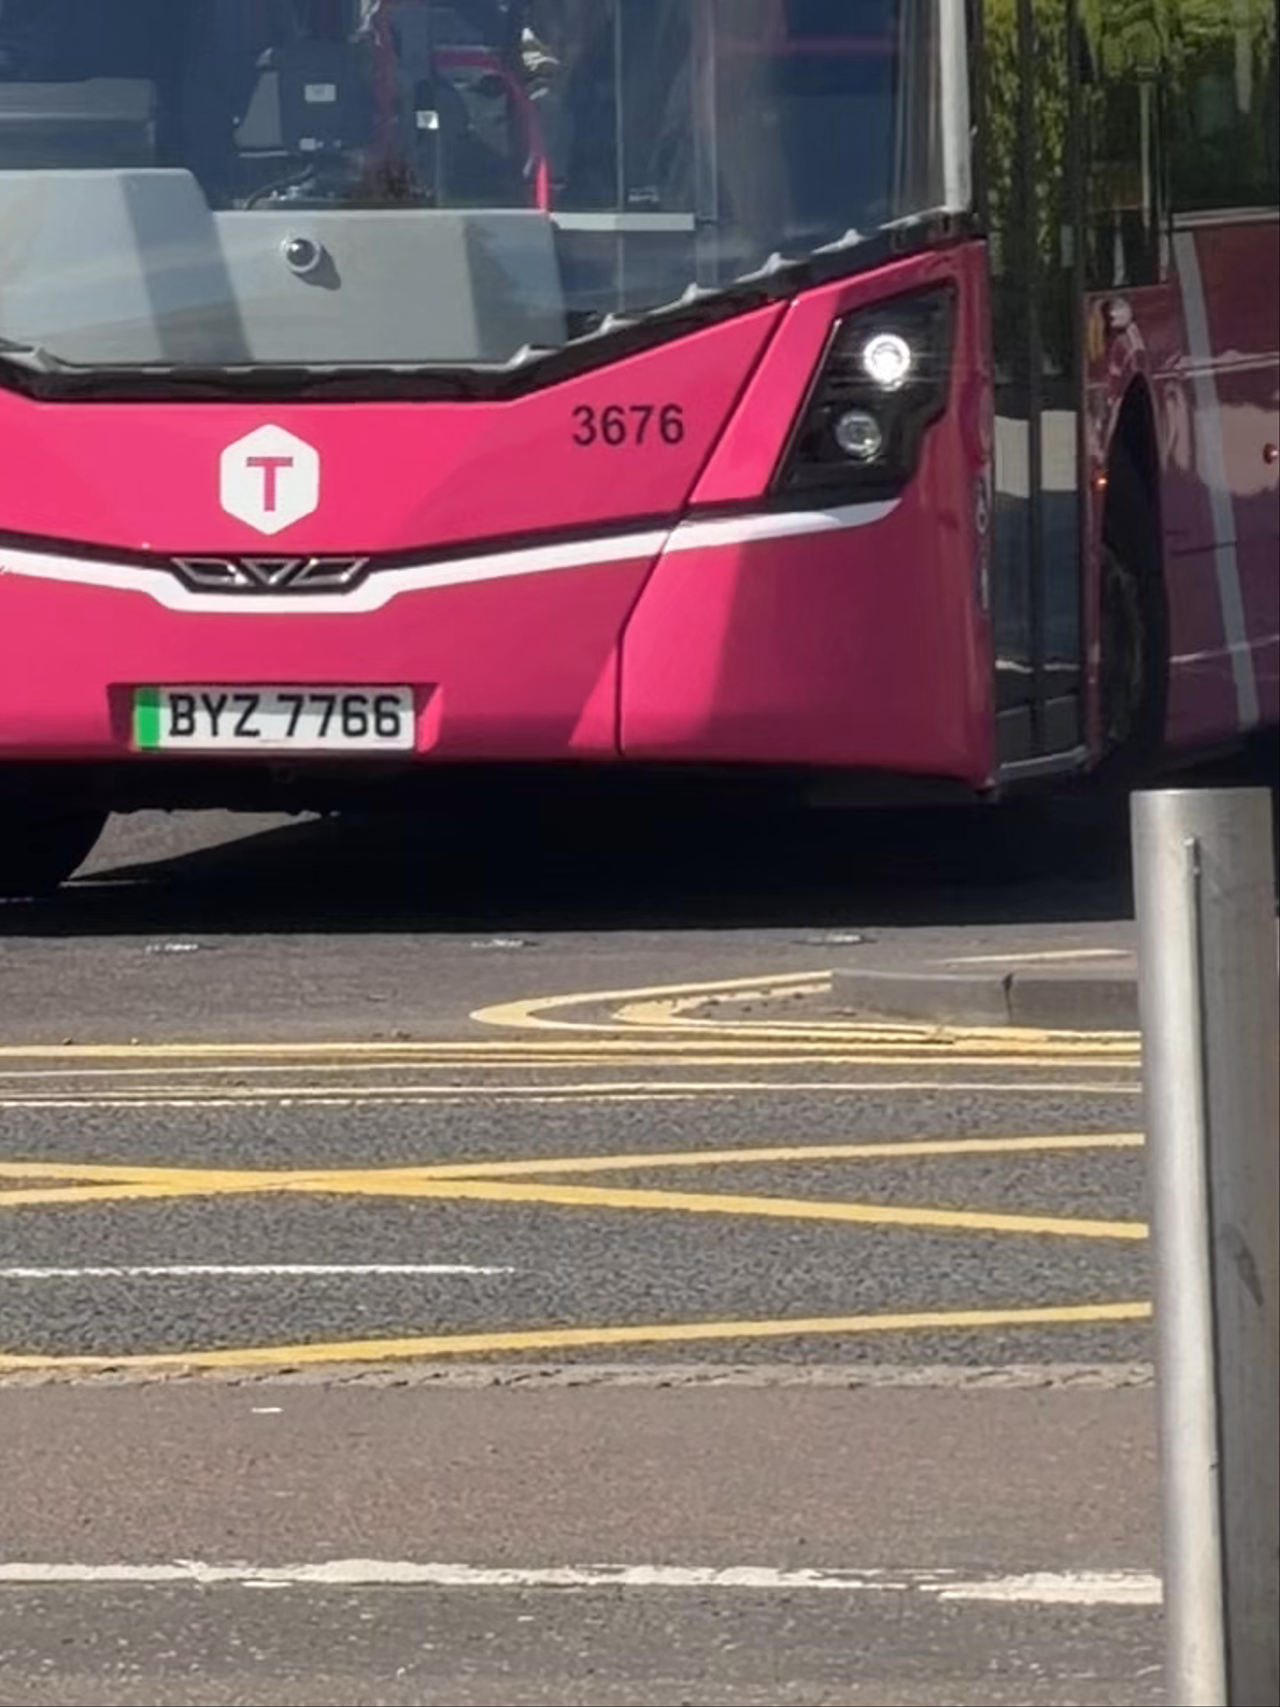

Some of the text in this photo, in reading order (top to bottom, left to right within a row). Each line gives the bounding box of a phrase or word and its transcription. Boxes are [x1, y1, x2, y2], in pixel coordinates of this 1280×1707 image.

[573, 405, 685, 445] 3676
[246, 456, 294, 513] T
[167, 692, 402, 737] BYZ 7766
